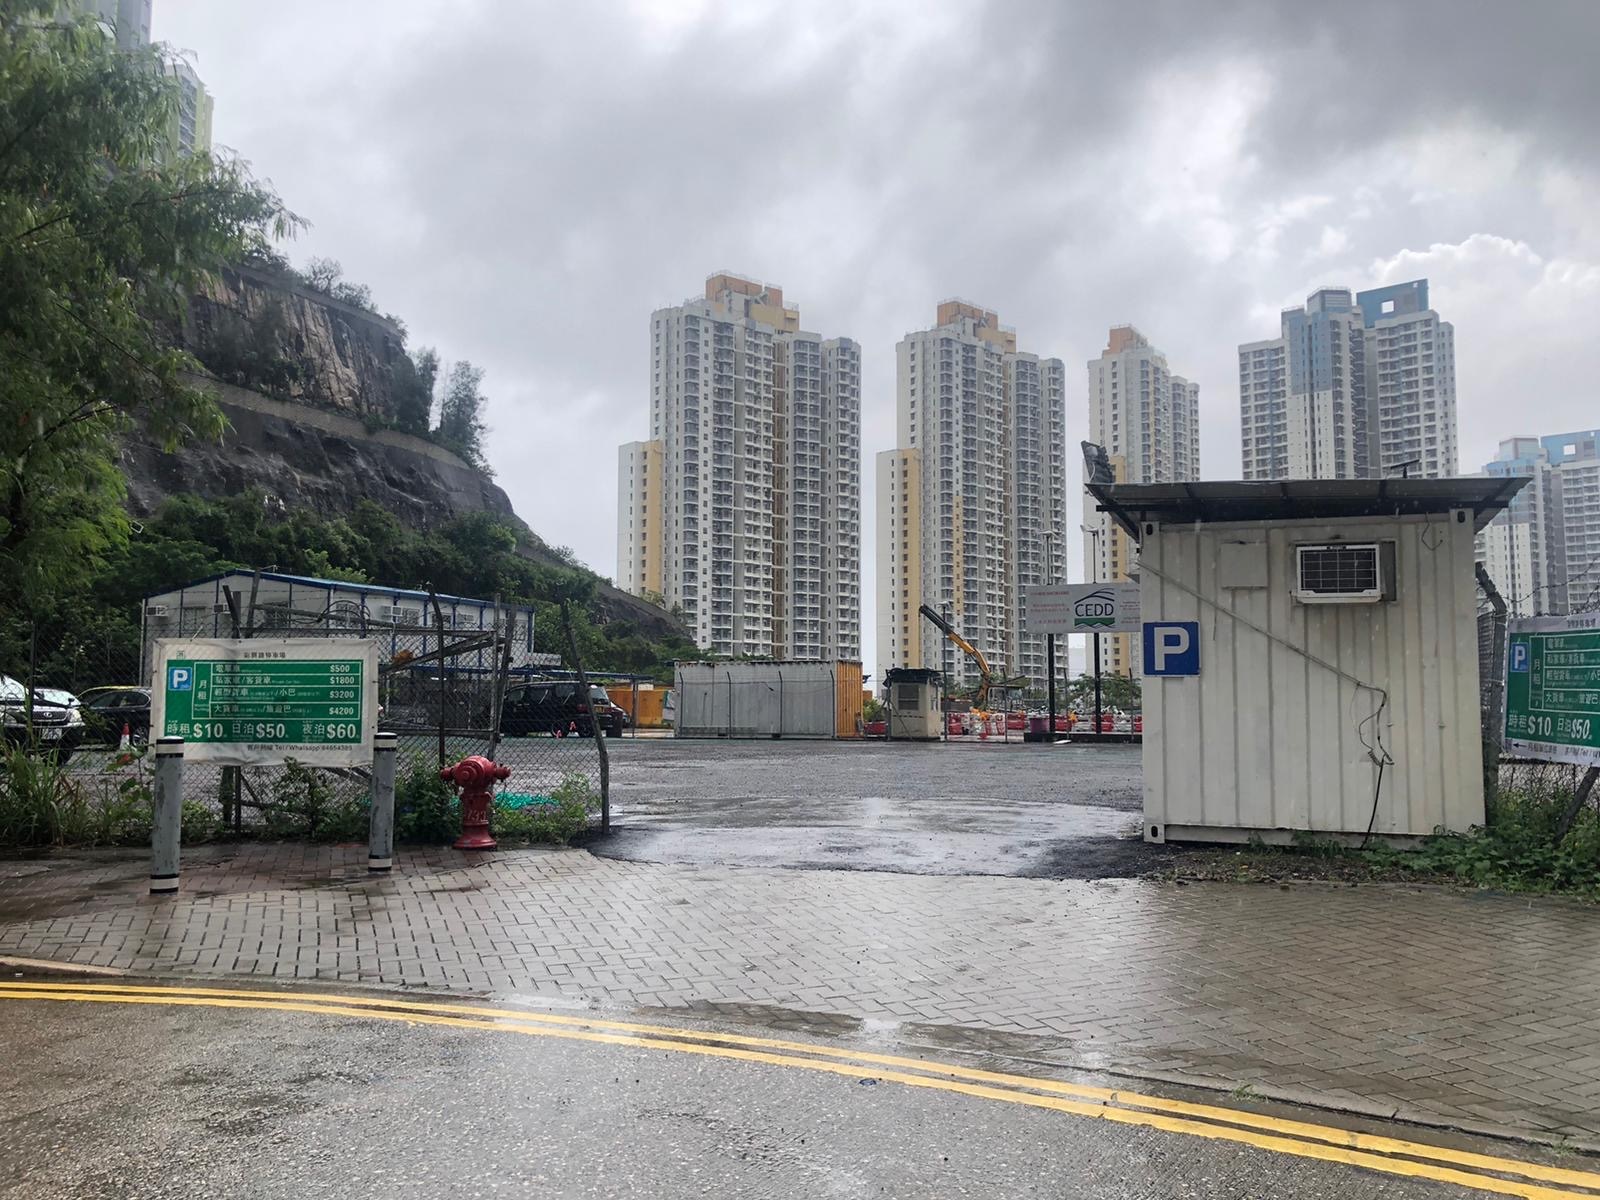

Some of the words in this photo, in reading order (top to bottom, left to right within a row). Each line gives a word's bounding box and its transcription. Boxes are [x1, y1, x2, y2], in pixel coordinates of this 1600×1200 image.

[1075, 604, 1114, 617] CEDD
[1154, 627, 1189, 670] P
[1515, 645, 1526, 669] P
[330, 664, 350, 674] $500
[173, 669, 188, 688] P
[330, 675, 355, 685] $1800
[329, 690, 355, 700] $3200
[329, 706, 354, 716] $4200
[193, 722, 224, 739] $10
[256, 722, 286, 739] $50
[327, 722, 356, 739] $60
[1527, 715, 1551, 737] $10
[1571, 718, 1591, 740] $50
